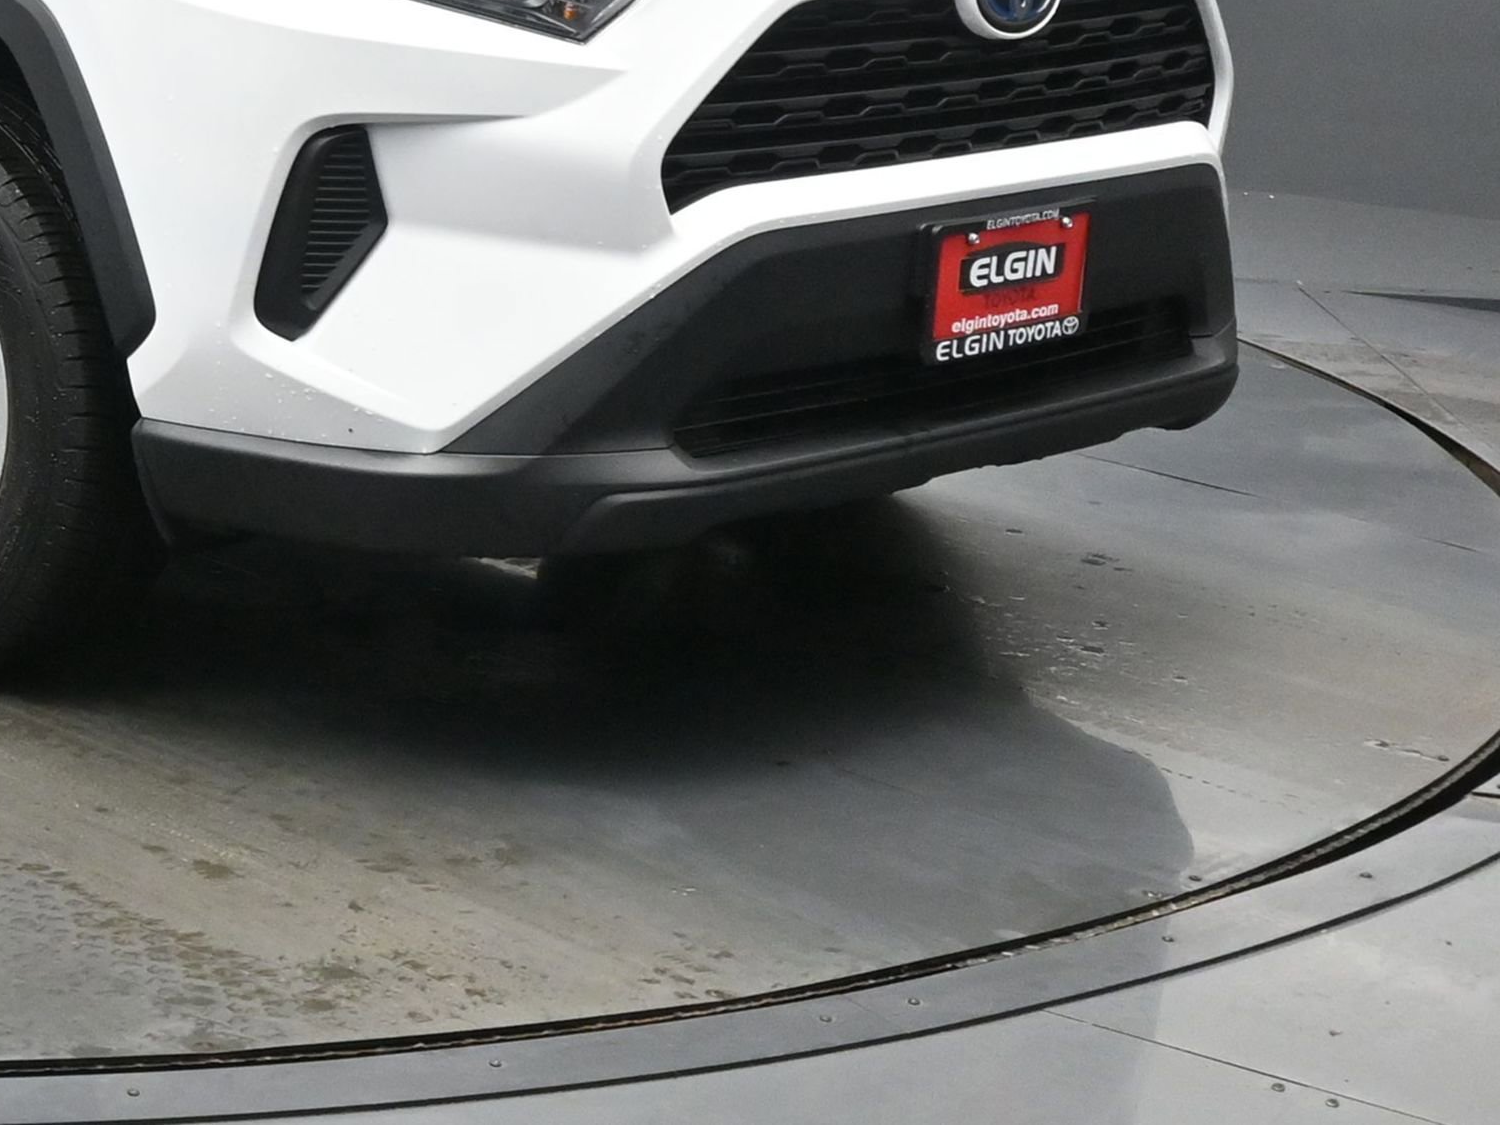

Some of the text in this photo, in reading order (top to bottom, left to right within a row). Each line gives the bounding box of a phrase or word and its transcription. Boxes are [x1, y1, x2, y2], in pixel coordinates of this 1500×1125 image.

[969, 245, 1058, 288] ELGIN
[951, 303, 1059, 334] elgintoyota.com
[935, 320, 1062, 362] ELGIN TOYOTA
